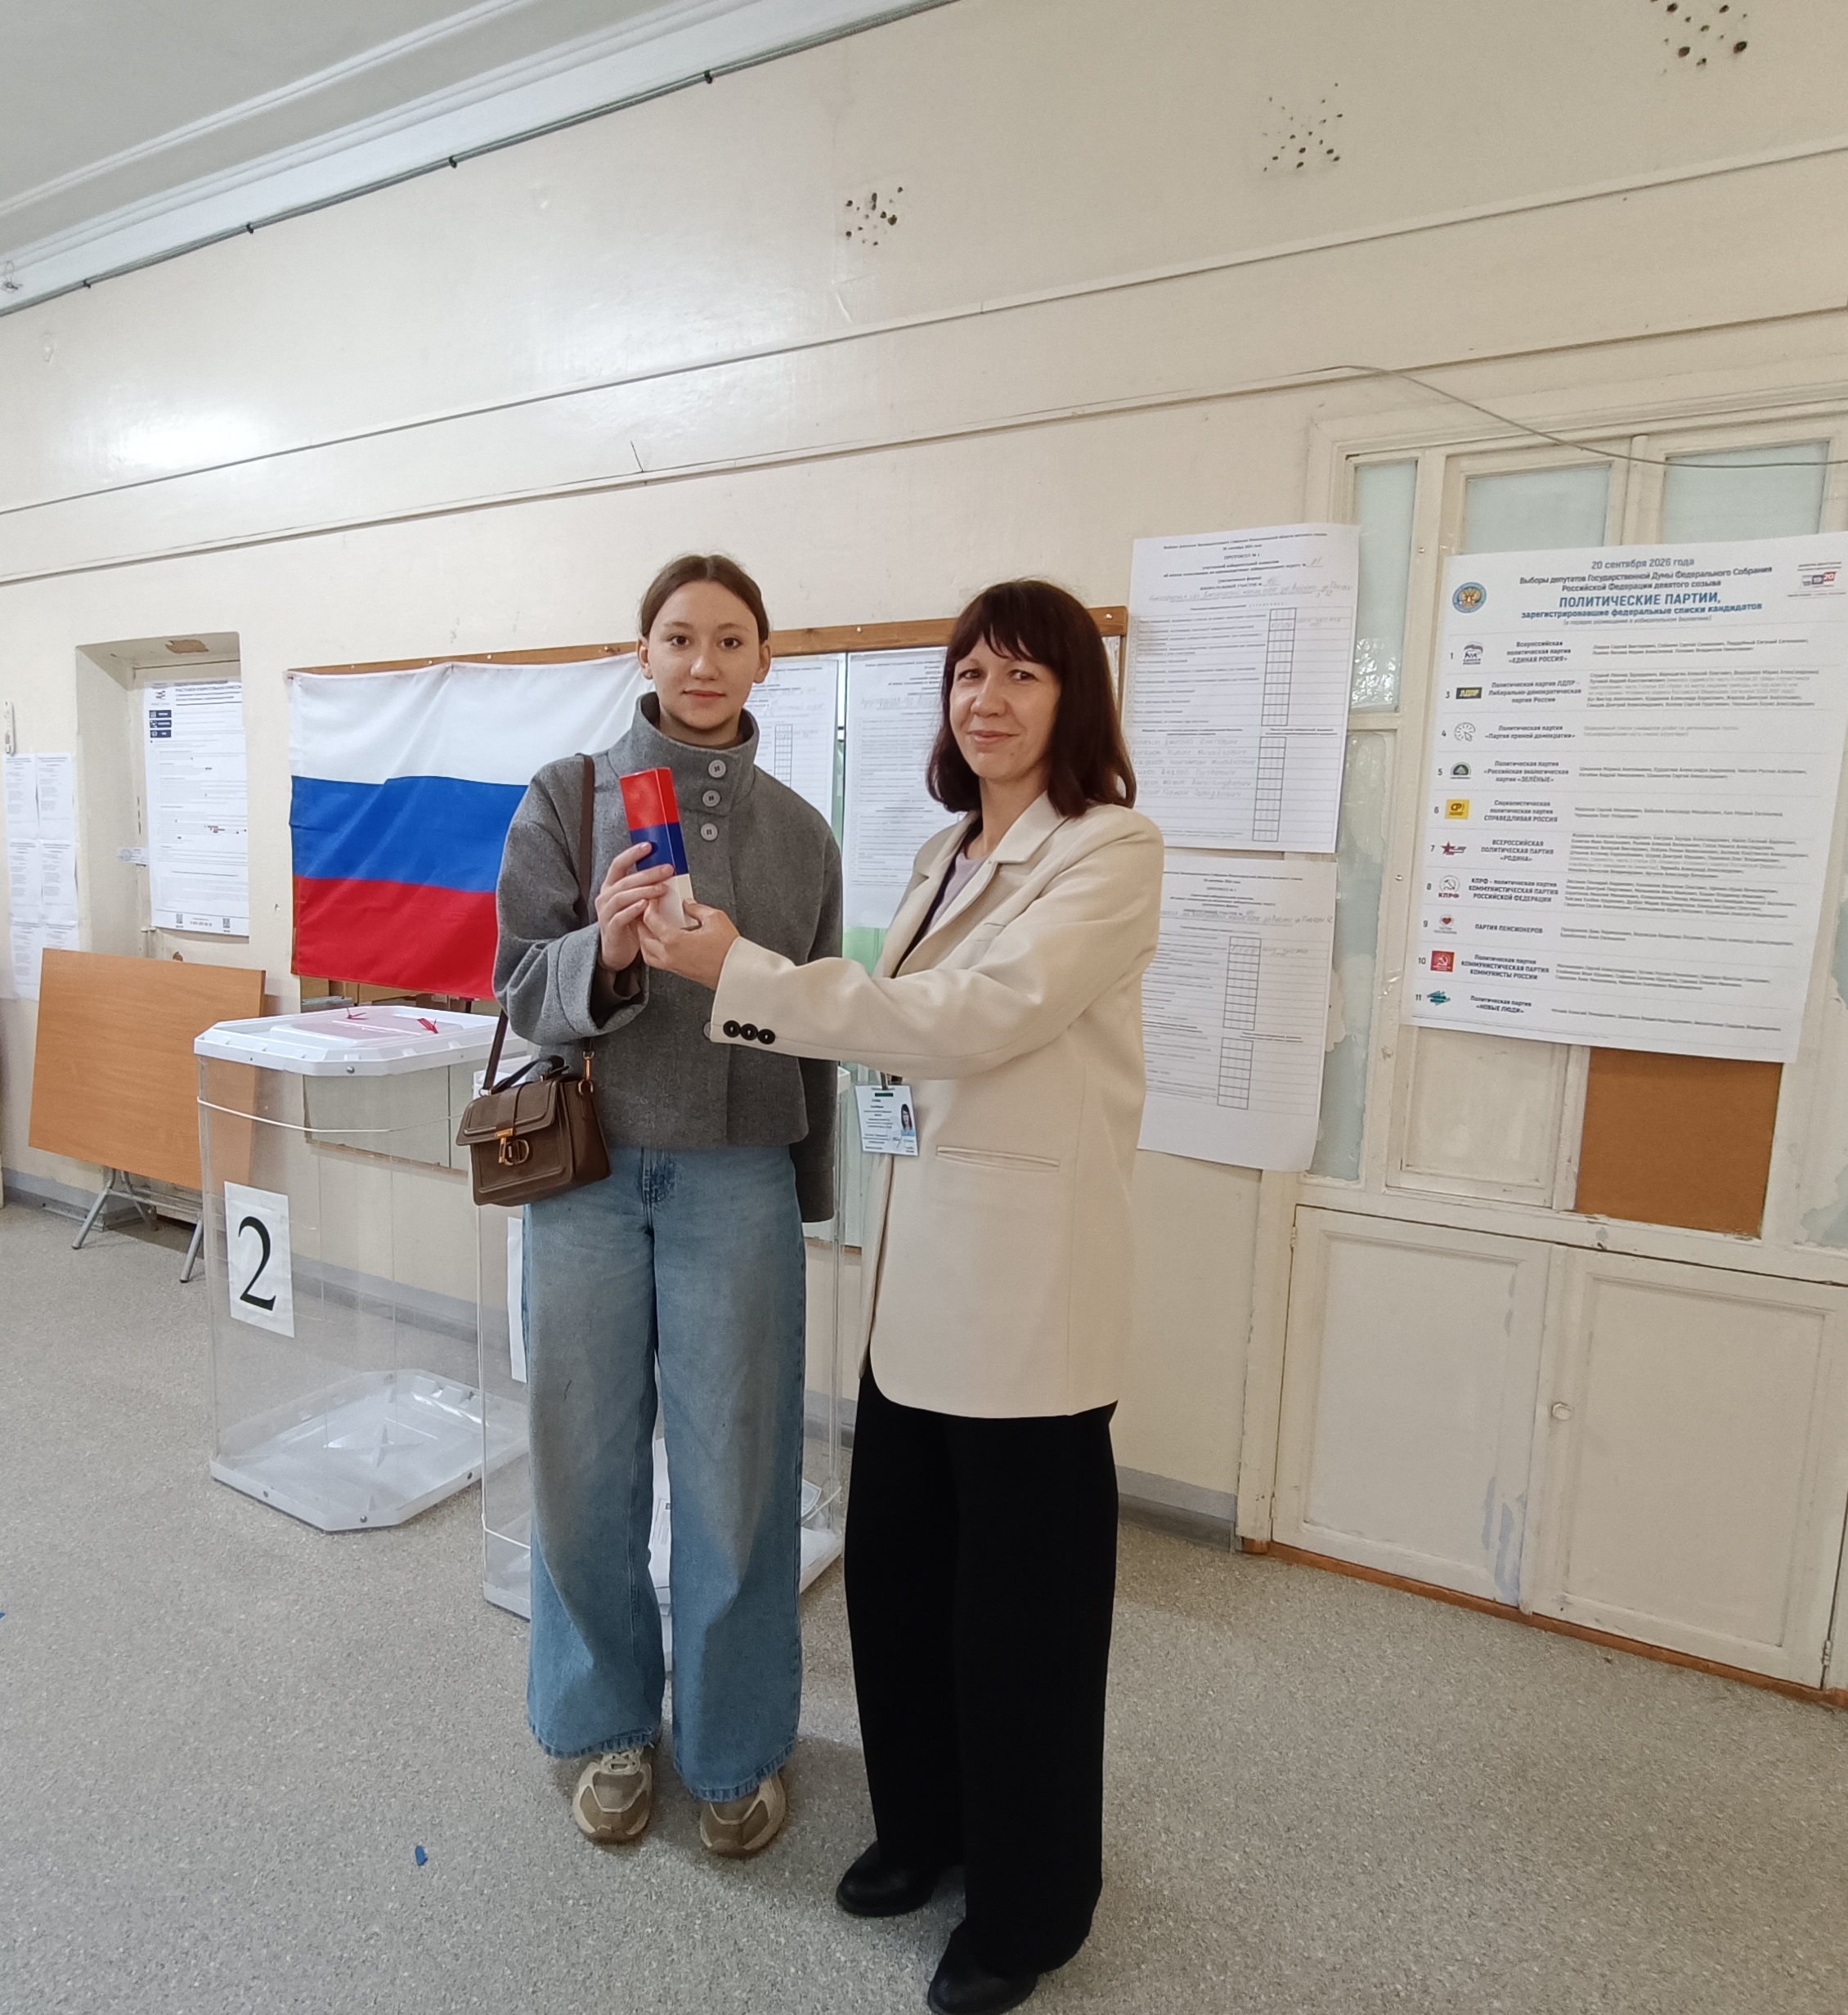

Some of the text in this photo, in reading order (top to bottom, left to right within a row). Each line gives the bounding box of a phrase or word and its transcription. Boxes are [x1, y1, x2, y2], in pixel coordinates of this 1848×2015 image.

[1591, 558, 1694, 570] 20 сентября 2026 года
[1519, 567, 1773, 585] Выборы депутатов Государственной Думы Федерального Собрания
[1562, 583, 1607, 592] Российской
[1608, 582, 1653, 590] Федерации
[1653, 581, 1689, 589] девятого
[1559, 592, 1720, 608] ПОЛИТИЧЕСКИЕ ПАРТИИ,
[1521, 610, 1609, 620] зарегистрировавшие
[1611, 608, 1671, 617] федеральные
[1674, 606, 1706, 615] списки
[1707, 603, 1762, 613] кандидатов
[1516, 640, 1563, 648] Всероссийская
[1556, 680, 1576, 688] ЛДПР
[1445, 691, 1451, 699] 3
[1441, 729, 1447, 738] 4
[1438, 768, 1443, 776] 5
[1492, 838, 1544, 846] ВСЕРОССИЙСКАЯ
[1426, 882, 1432, 891] 8
[1469, 885, 1532, 895] КОММУНИСТИЧЕСКАЯ
[1473, 892, 1513, 901] РОССИЙСКОЙ
[1498, 926, 1543, 934] ПЕНСИОНЕРОВ
[1418, 957, 1426, 965] 10
[1460, 960, 1524, 972] КОММУНИСТИЧЕСКАЯ
[1469, 969, 1513, 979] КОММУНИСТЫ
[237, 1215, 276, 1312] 2
